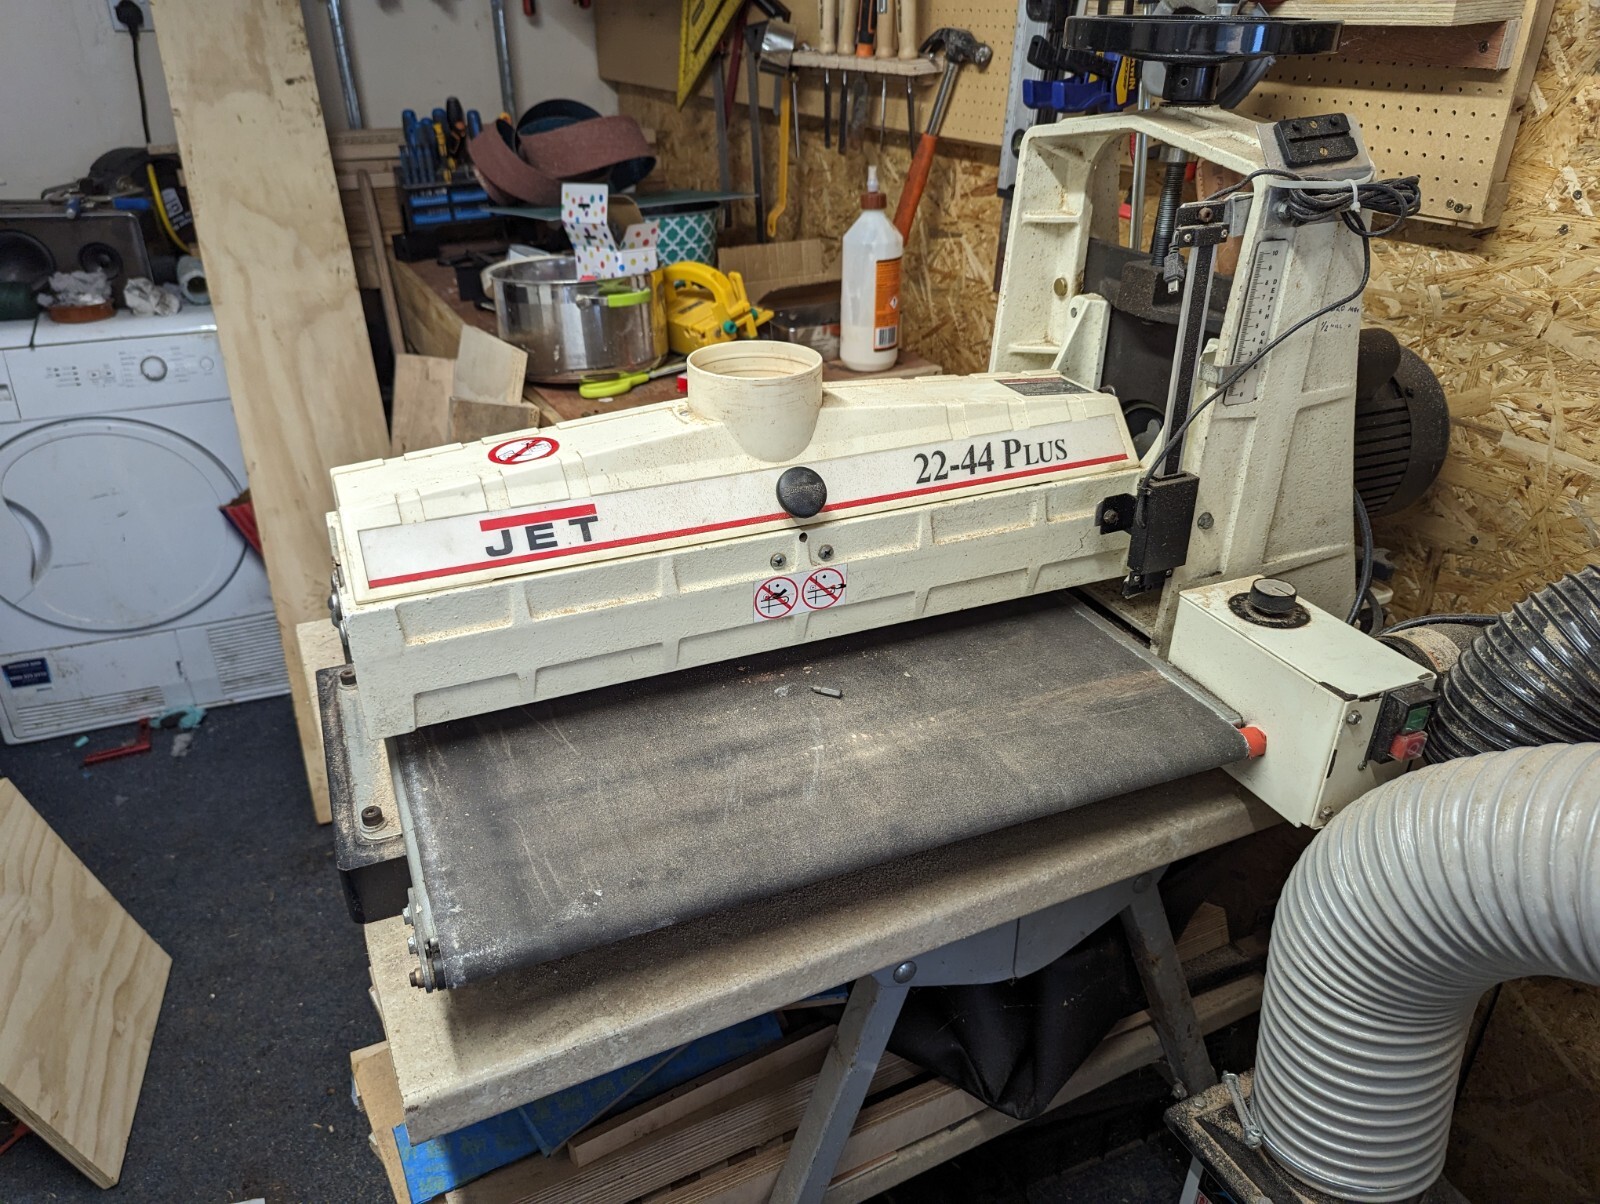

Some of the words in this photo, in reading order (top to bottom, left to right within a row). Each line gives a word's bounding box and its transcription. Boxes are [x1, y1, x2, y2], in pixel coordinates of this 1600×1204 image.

[1264, 279, 1278, 320] DEPTH
[1253, 330, 1266, 370] GAUE
[913, 441, 995, 485] 22-44
[485, 515, 599, 557] JET
